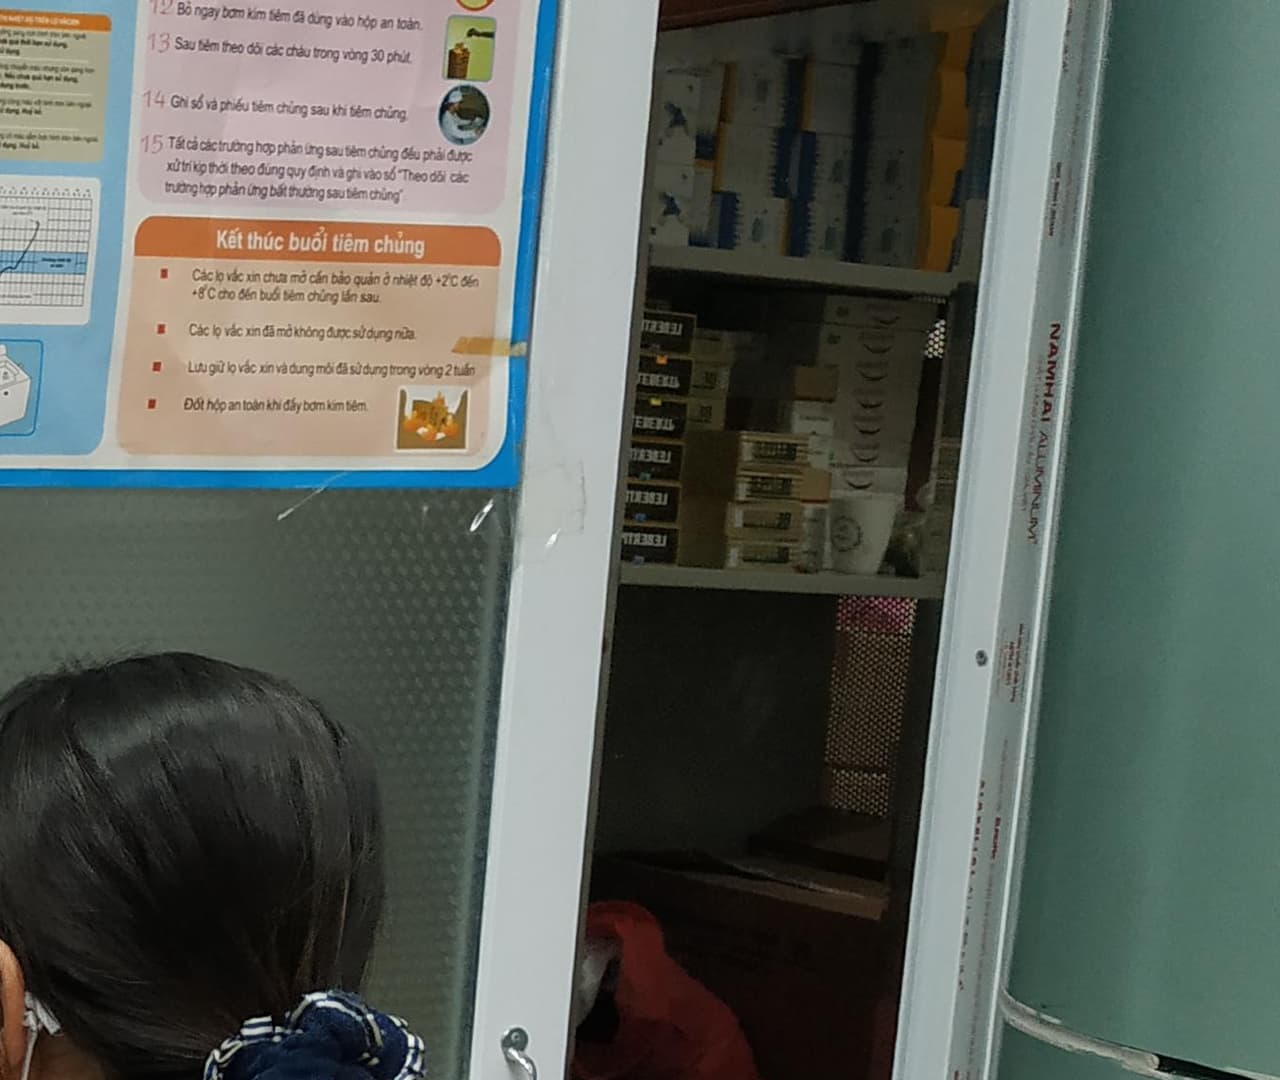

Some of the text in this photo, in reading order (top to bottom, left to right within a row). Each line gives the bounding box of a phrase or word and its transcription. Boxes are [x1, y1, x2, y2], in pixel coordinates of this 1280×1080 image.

[148, 32, 171, 53] 13
[215, 225, 426, 260] Kết thúc buổi tiêm chủng
[1040, 322, 1061, 423] NAMHAI
